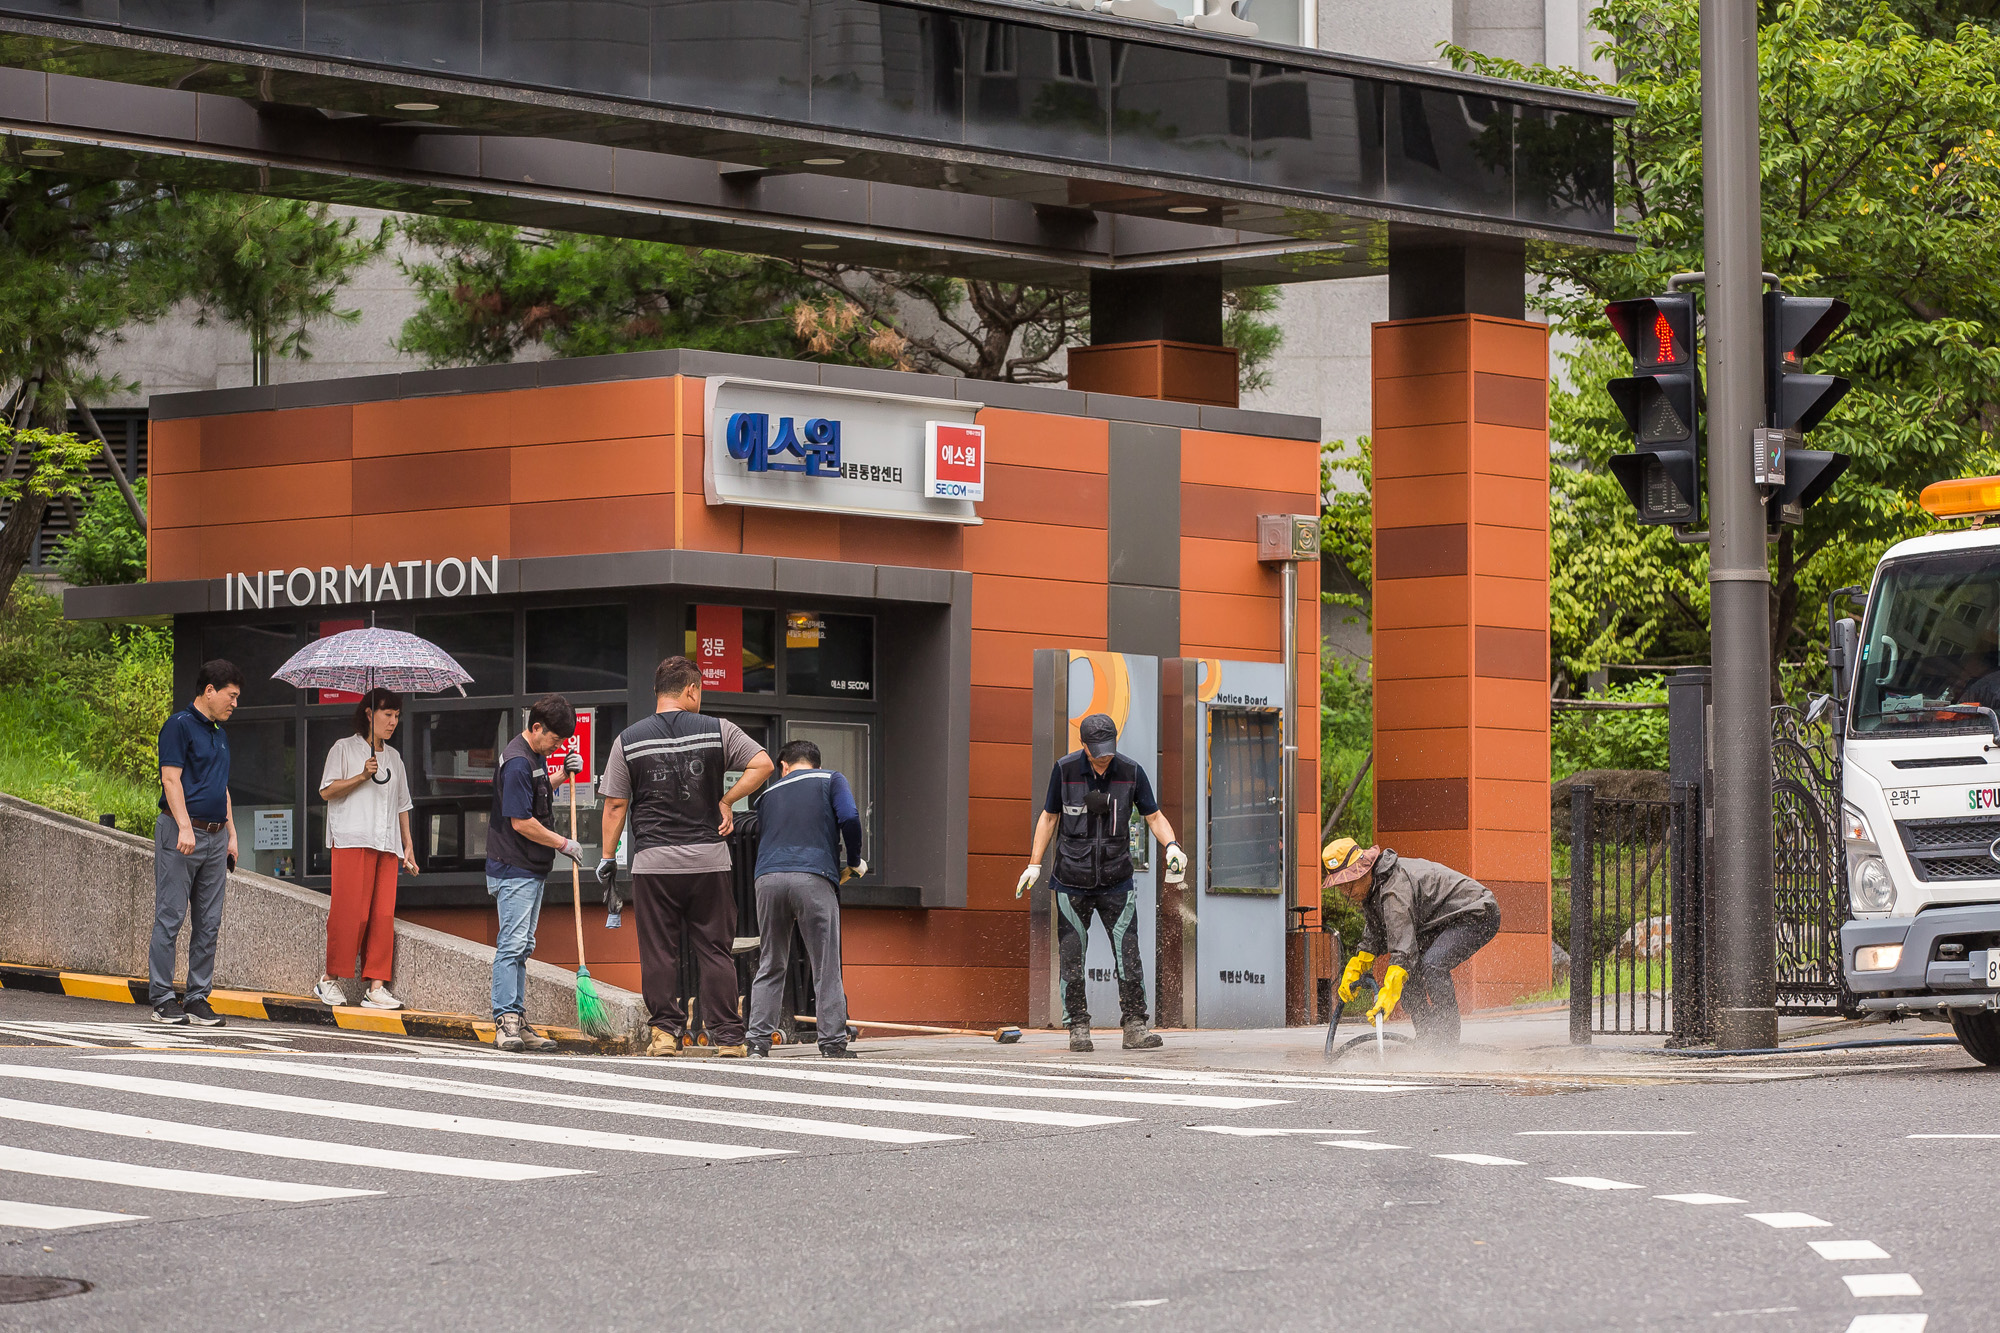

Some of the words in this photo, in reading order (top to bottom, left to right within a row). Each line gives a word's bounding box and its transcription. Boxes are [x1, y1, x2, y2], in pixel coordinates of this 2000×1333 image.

[727, 412, 841, 477] 에스원
[941, 445, 976, 467] 에스원
[936, 483, 967, 496] SECOM
[226, 555, 499, 611] INFORMATION
[702, 638, 725, 657] 정문
[831, 680, 846, 689] 에스원
[847, 681, 870, 690] SECOM
[1217, 693, 1242, 704] Notice
[1244, 695, 1268, 705] Board
[1890, 790, 1920, 806] 은평구
